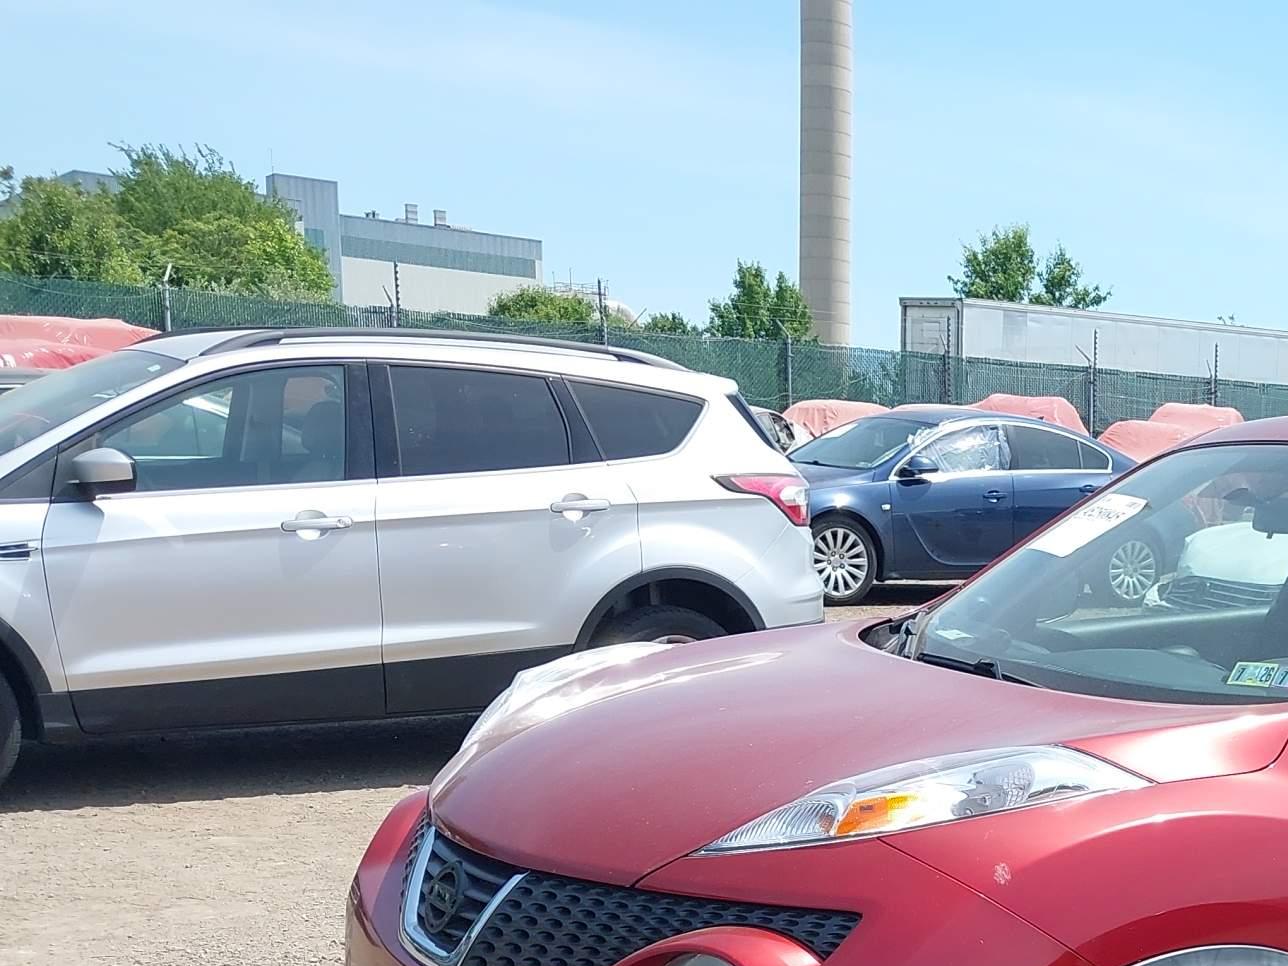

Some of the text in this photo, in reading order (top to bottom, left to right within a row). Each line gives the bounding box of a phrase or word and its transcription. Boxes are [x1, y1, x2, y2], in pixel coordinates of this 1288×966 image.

[1235, 667, 1274, 682] 7 26
[1279, 670, 1288, 685] 7
